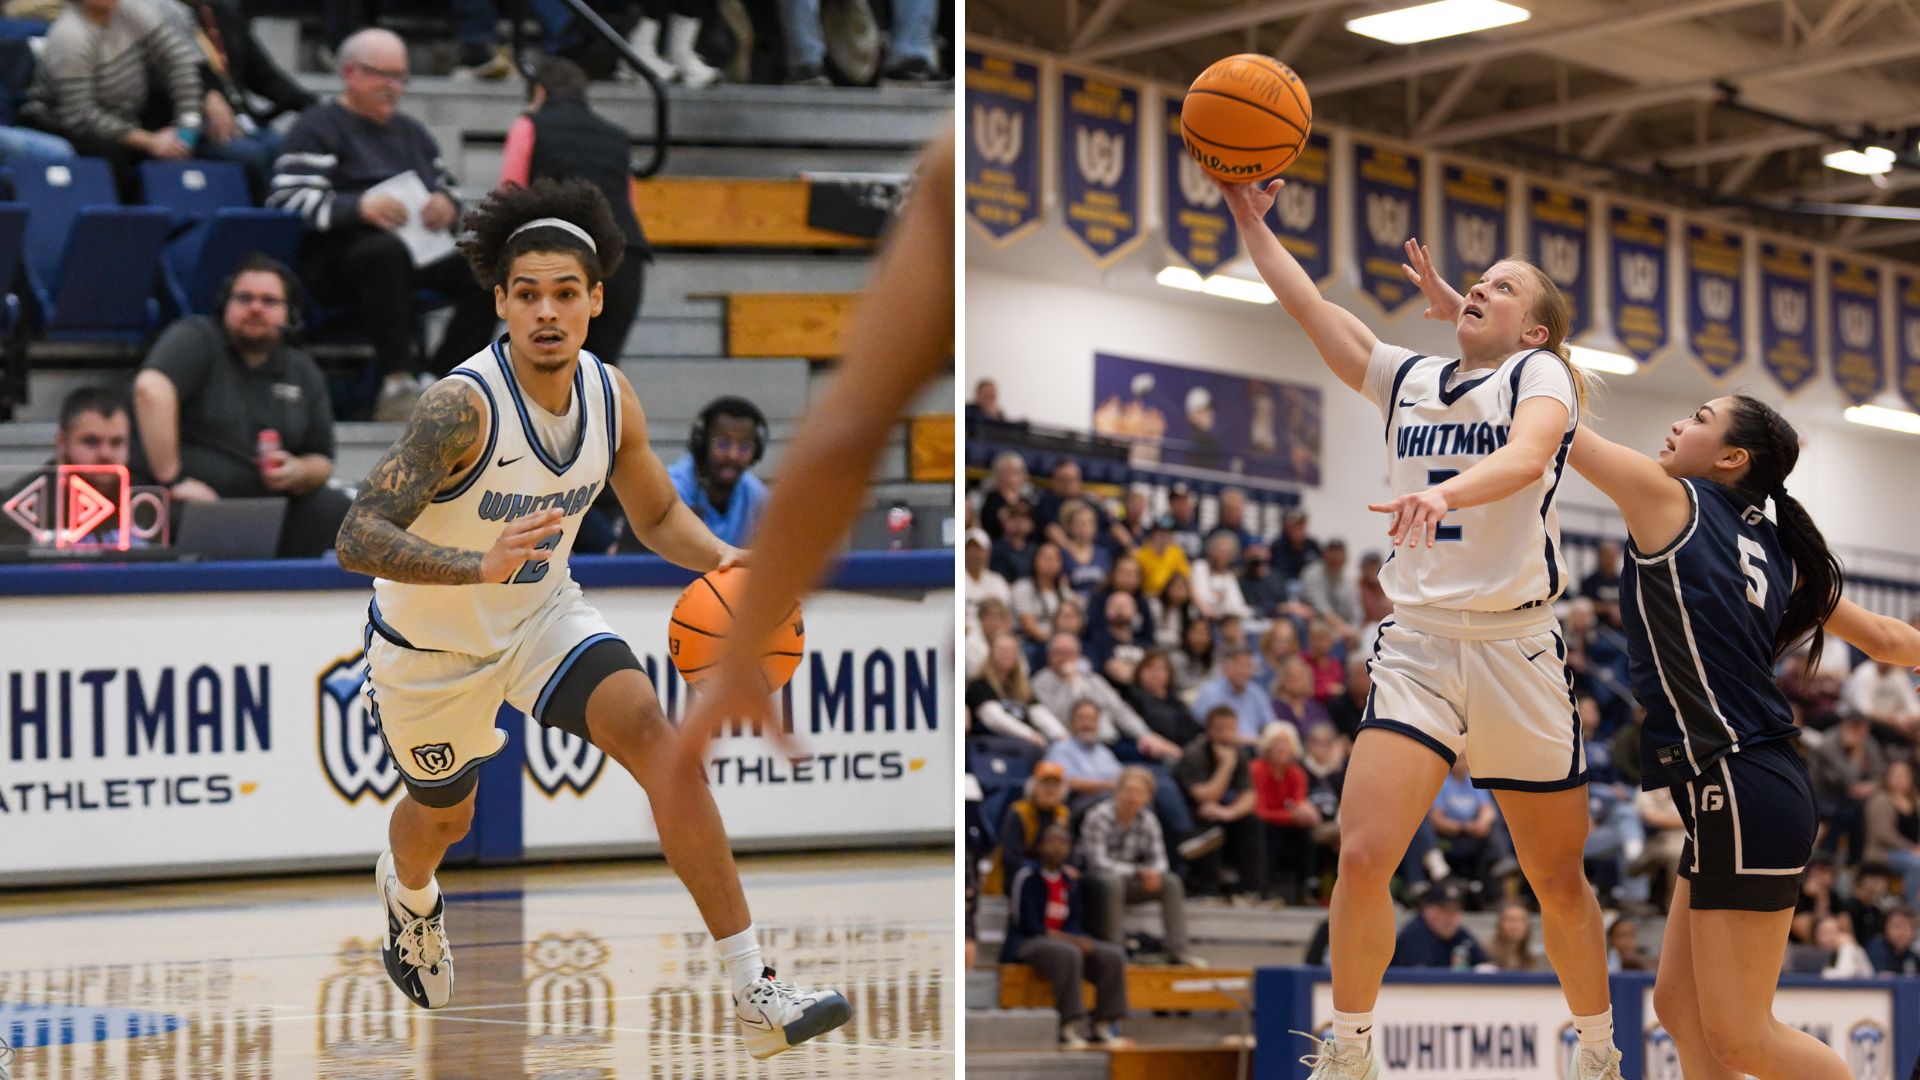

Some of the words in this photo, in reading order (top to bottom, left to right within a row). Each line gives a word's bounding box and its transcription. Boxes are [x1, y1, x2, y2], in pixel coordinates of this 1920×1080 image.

[1396, 421, 1511, 460] WHITMAN
[1738, 534, 1768, 610] 5
[9, 664, 271, 760] HITMAN
[700, 751, 904, 786] THLETICS
[1383, 1023, 1539, 1071] WHITMAN
